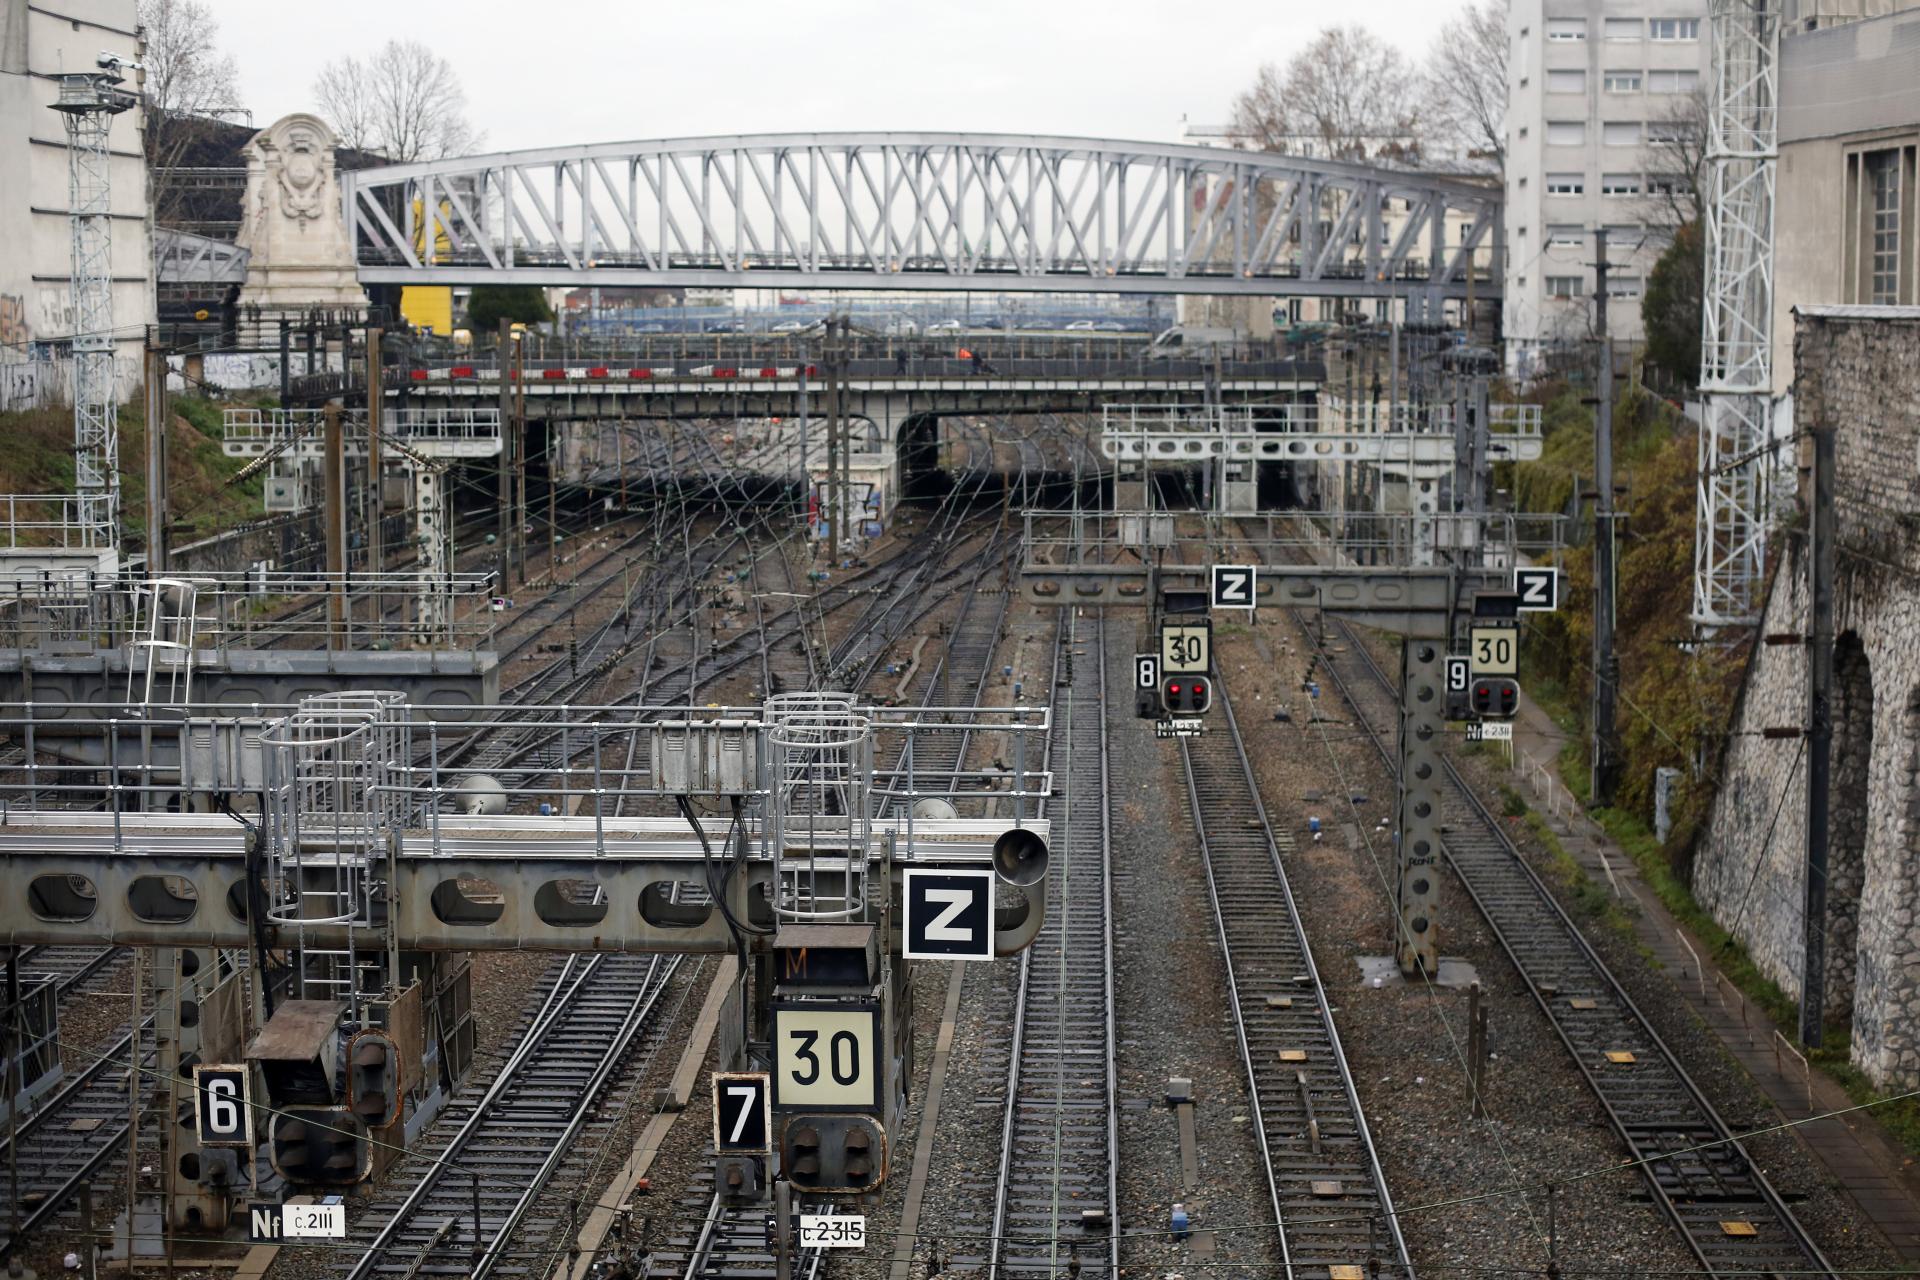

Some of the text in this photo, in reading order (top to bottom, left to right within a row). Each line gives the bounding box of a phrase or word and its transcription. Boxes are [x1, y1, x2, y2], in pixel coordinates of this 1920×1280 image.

[1222, 573, 1246, 600] Z
[1523, 575, 1548, 602] Z
[1169, 635, 1202, 663] 30
[1478, 638, 1511, 664] 30
[1140, 660, 1155, 687] 8
[1451, 662, 1466, 690] 9
[925, 888, 973, 942] Z
[785, 946, 807, 979] M
[790, 1030, 860, 1086] 30
[208, 1078, 238, 1134] 6
[727, 1086, 756, 1143] 7
[252, 1209, 282, 1238] Nf
